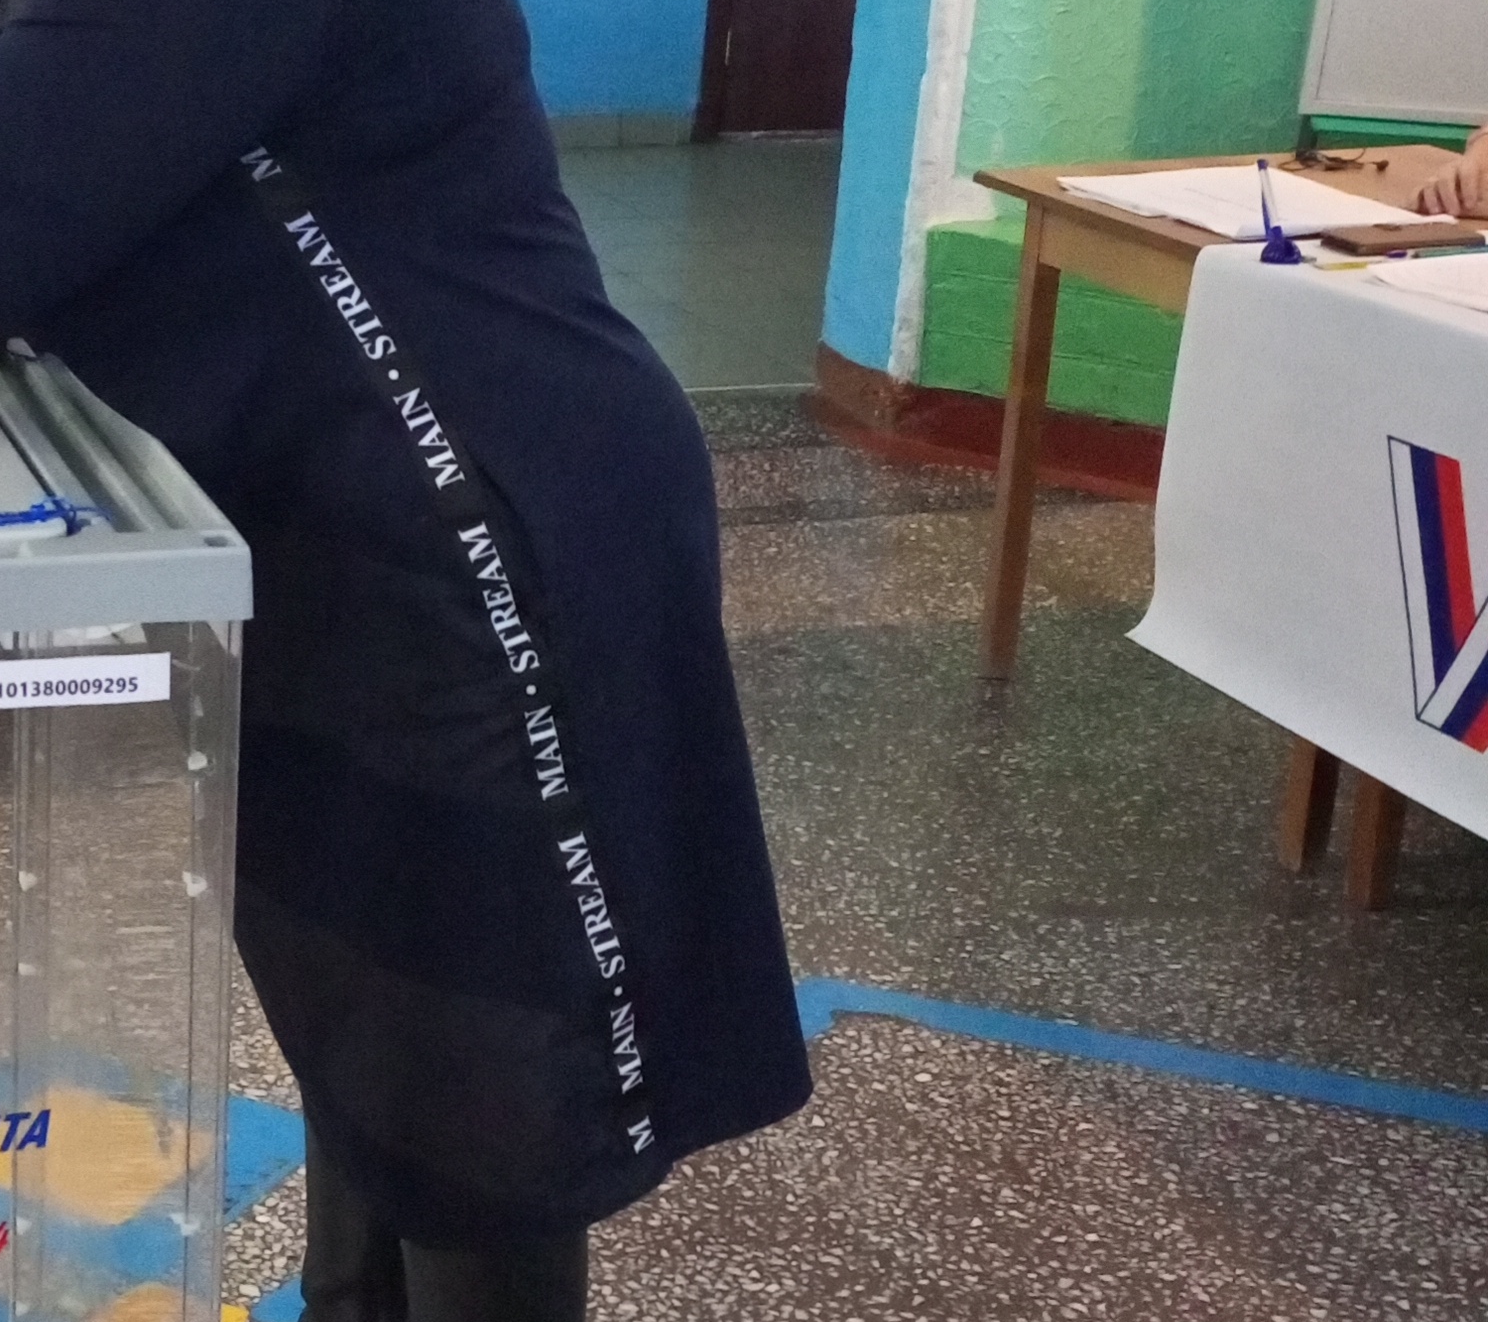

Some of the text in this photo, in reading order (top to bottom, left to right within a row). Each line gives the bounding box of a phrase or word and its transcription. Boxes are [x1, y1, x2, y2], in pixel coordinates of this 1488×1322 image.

[284, 211, 465, 490] MAIN STREAM
[458, 522, 569, 800] MAIN STREAM
[557, 831, 643, 1093] MAIN STREAM
